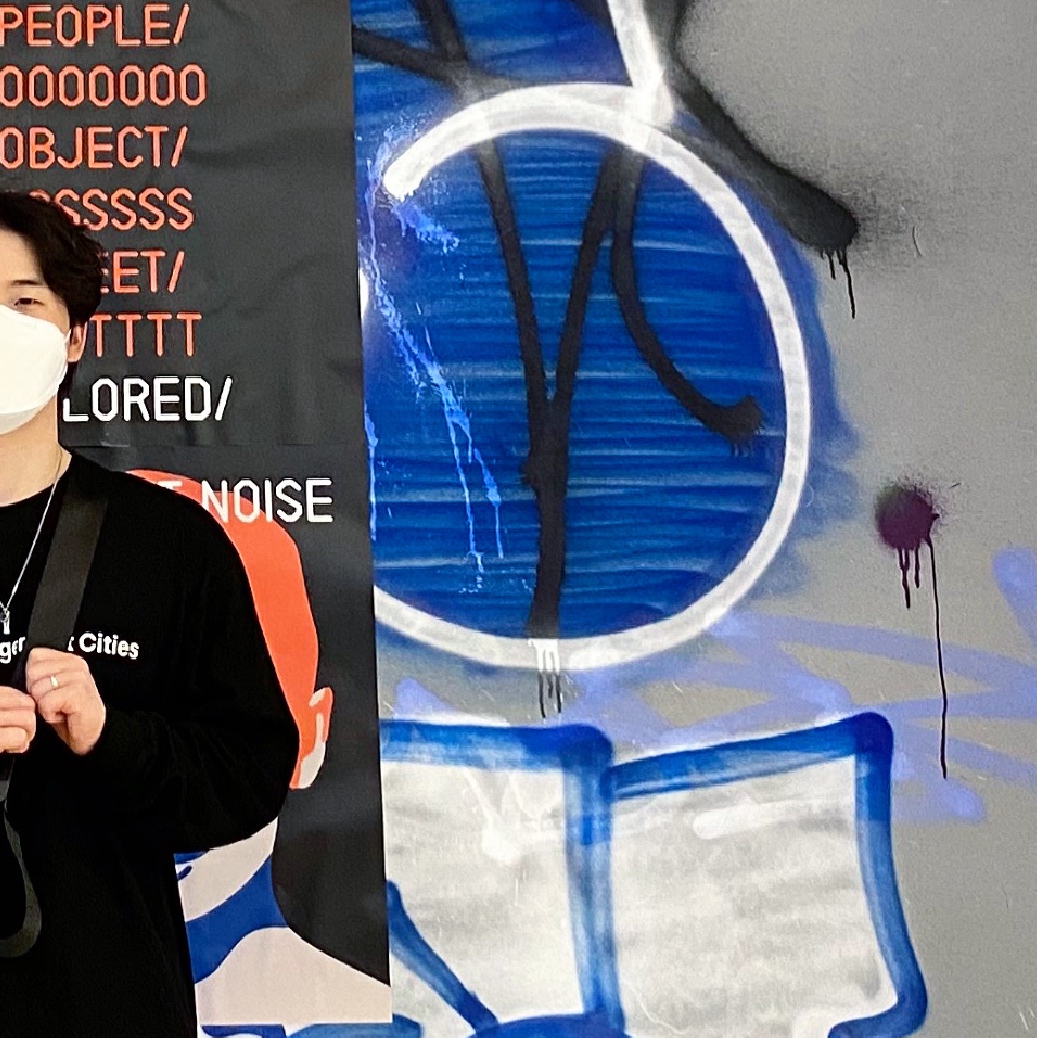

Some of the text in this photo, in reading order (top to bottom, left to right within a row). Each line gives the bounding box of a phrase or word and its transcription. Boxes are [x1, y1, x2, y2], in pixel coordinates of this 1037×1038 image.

[29, 187, 194, 231] SSSSS
[201, 478, 333, 523] NOISE
[79, 631, 140, 659] Cities
